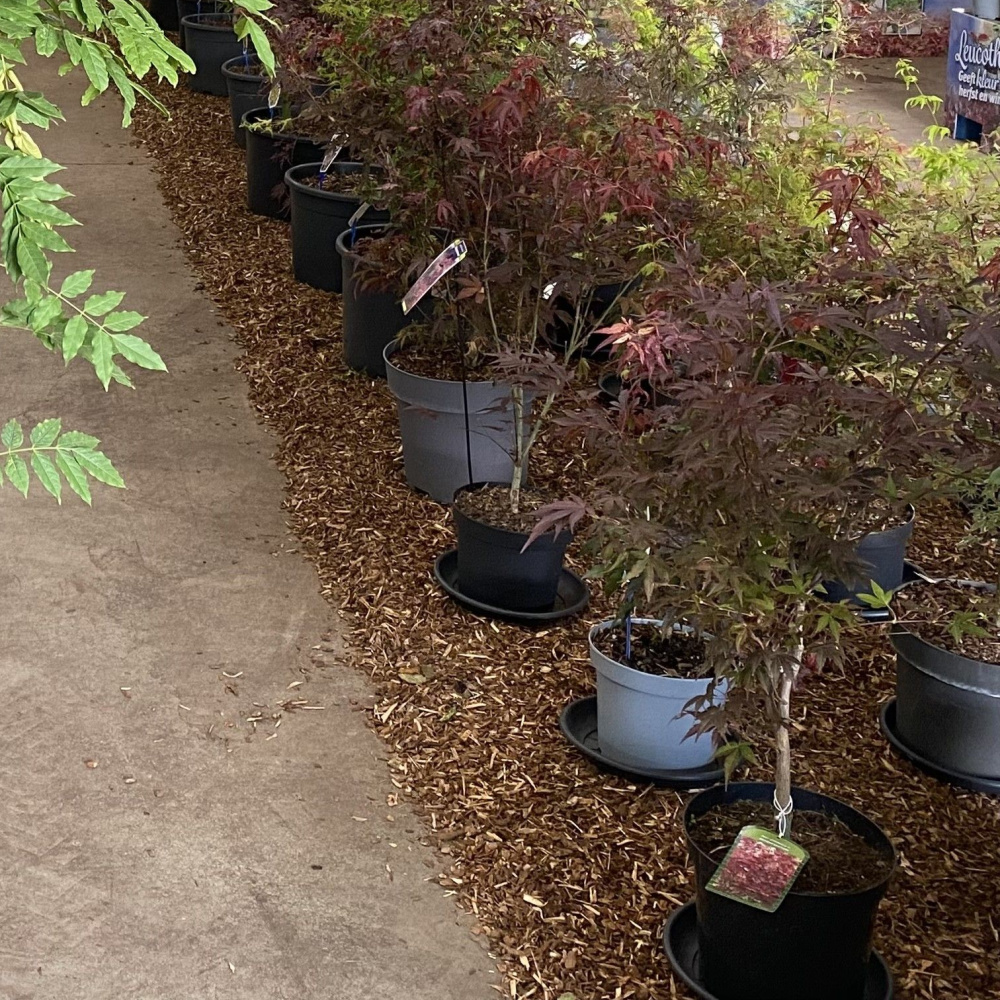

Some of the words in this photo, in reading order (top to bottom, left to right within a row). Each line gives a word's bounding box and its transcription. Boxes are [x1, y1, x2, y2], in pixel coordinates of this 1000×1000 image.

[958, 70, 976, 87] Geeft
[976, 68, 999, 91] kleur
[958, 84, 979, 101] herfst
[979, 91, 988, 102] en
